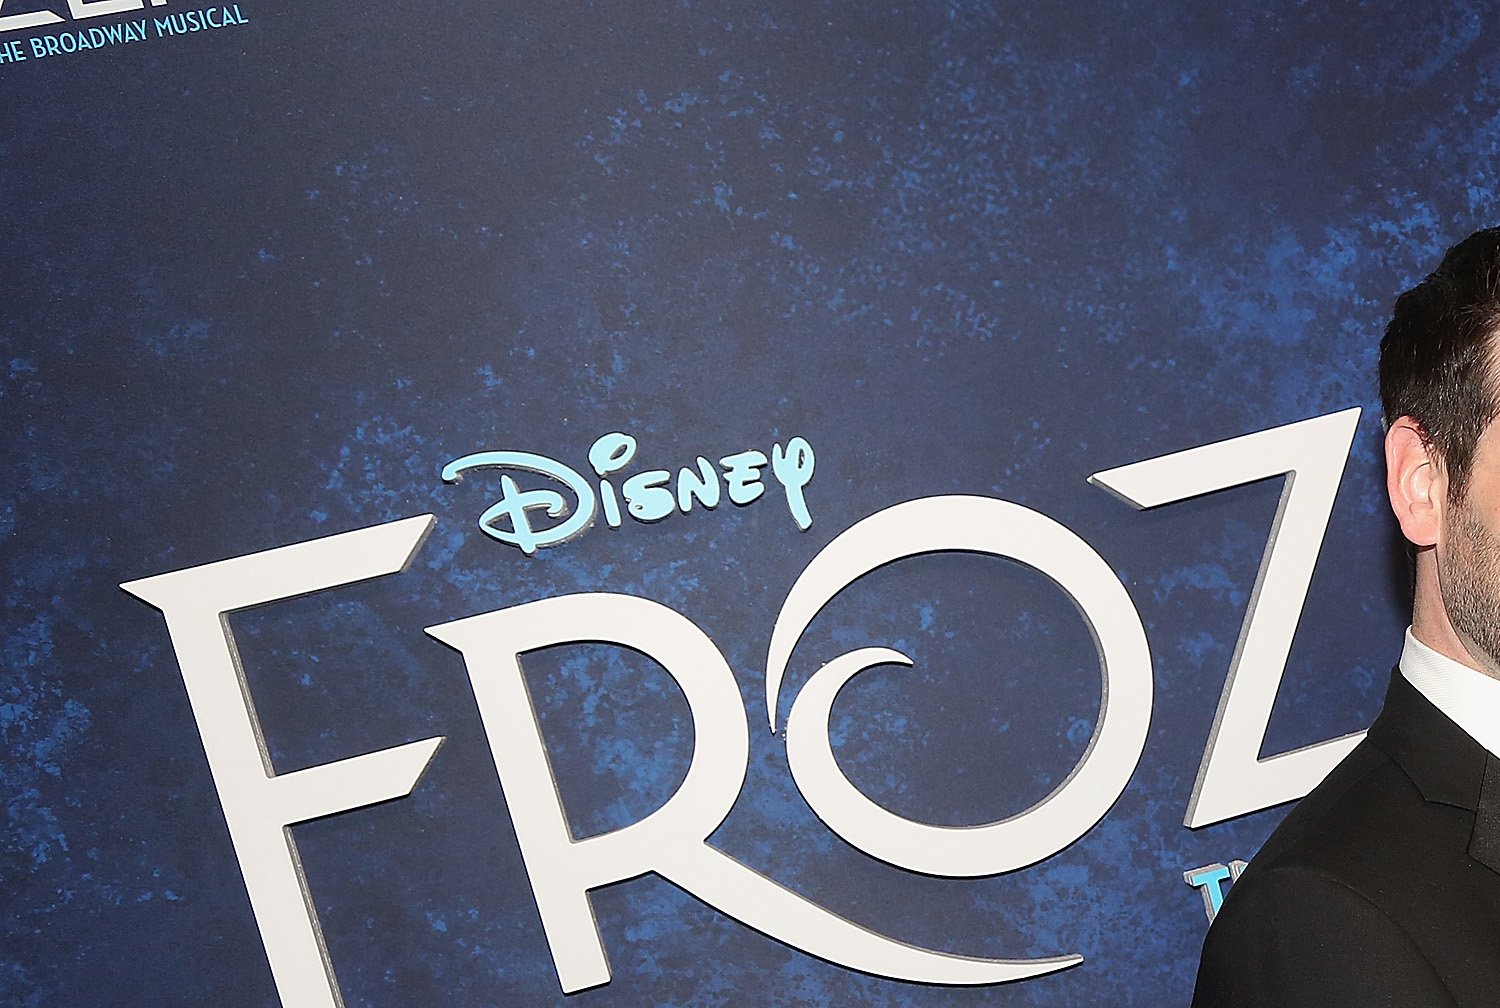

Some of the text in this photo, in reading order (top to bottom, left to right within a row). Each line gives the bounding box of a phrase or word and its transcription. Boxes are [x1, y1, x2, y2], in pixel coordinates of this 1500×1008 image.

[0, 41, 26, 64] HE
[29, 19, 147, 59] BROADWAY
[153, 4, 249, 37] MUSICAL
